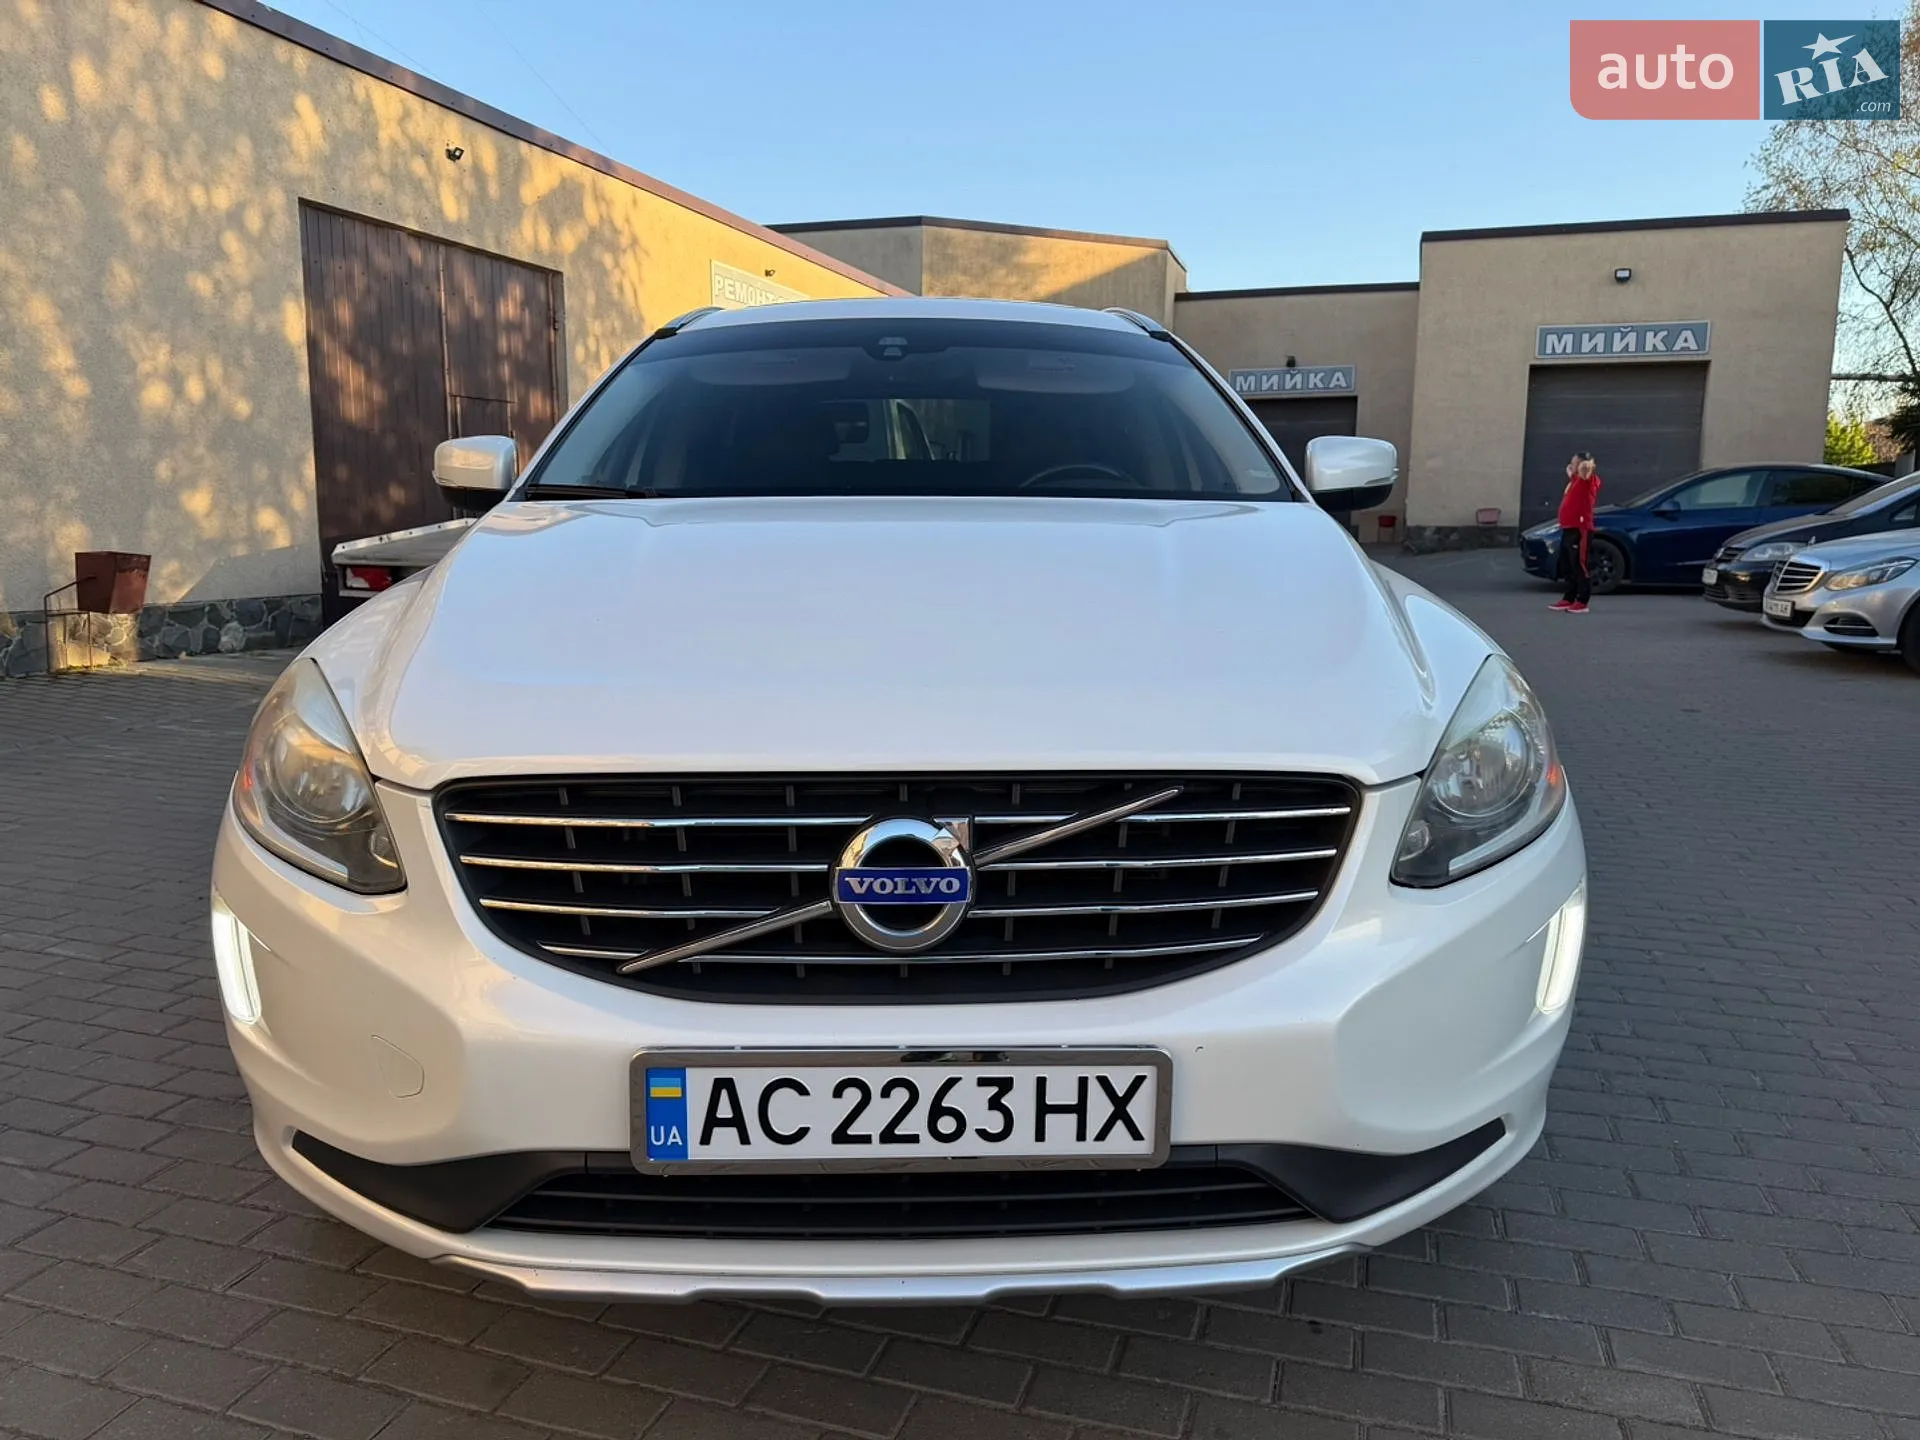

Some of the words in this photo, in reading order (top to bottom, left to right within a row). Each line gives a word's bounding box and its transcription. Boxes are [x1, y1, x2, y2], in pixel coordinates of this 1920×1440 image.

[1545, 326, 1699, 354] МИЙКА
[1235, 369, 1348, 392] МИЙКА
[844, 877, 961, 895] VOLVO
[699, 1077, 812, 1147] AC
[830, 1076, 1016, 1146] 2263
[1034, 1074, 1149, 1143] HX
[650, 1125, 683, 1147] UA
